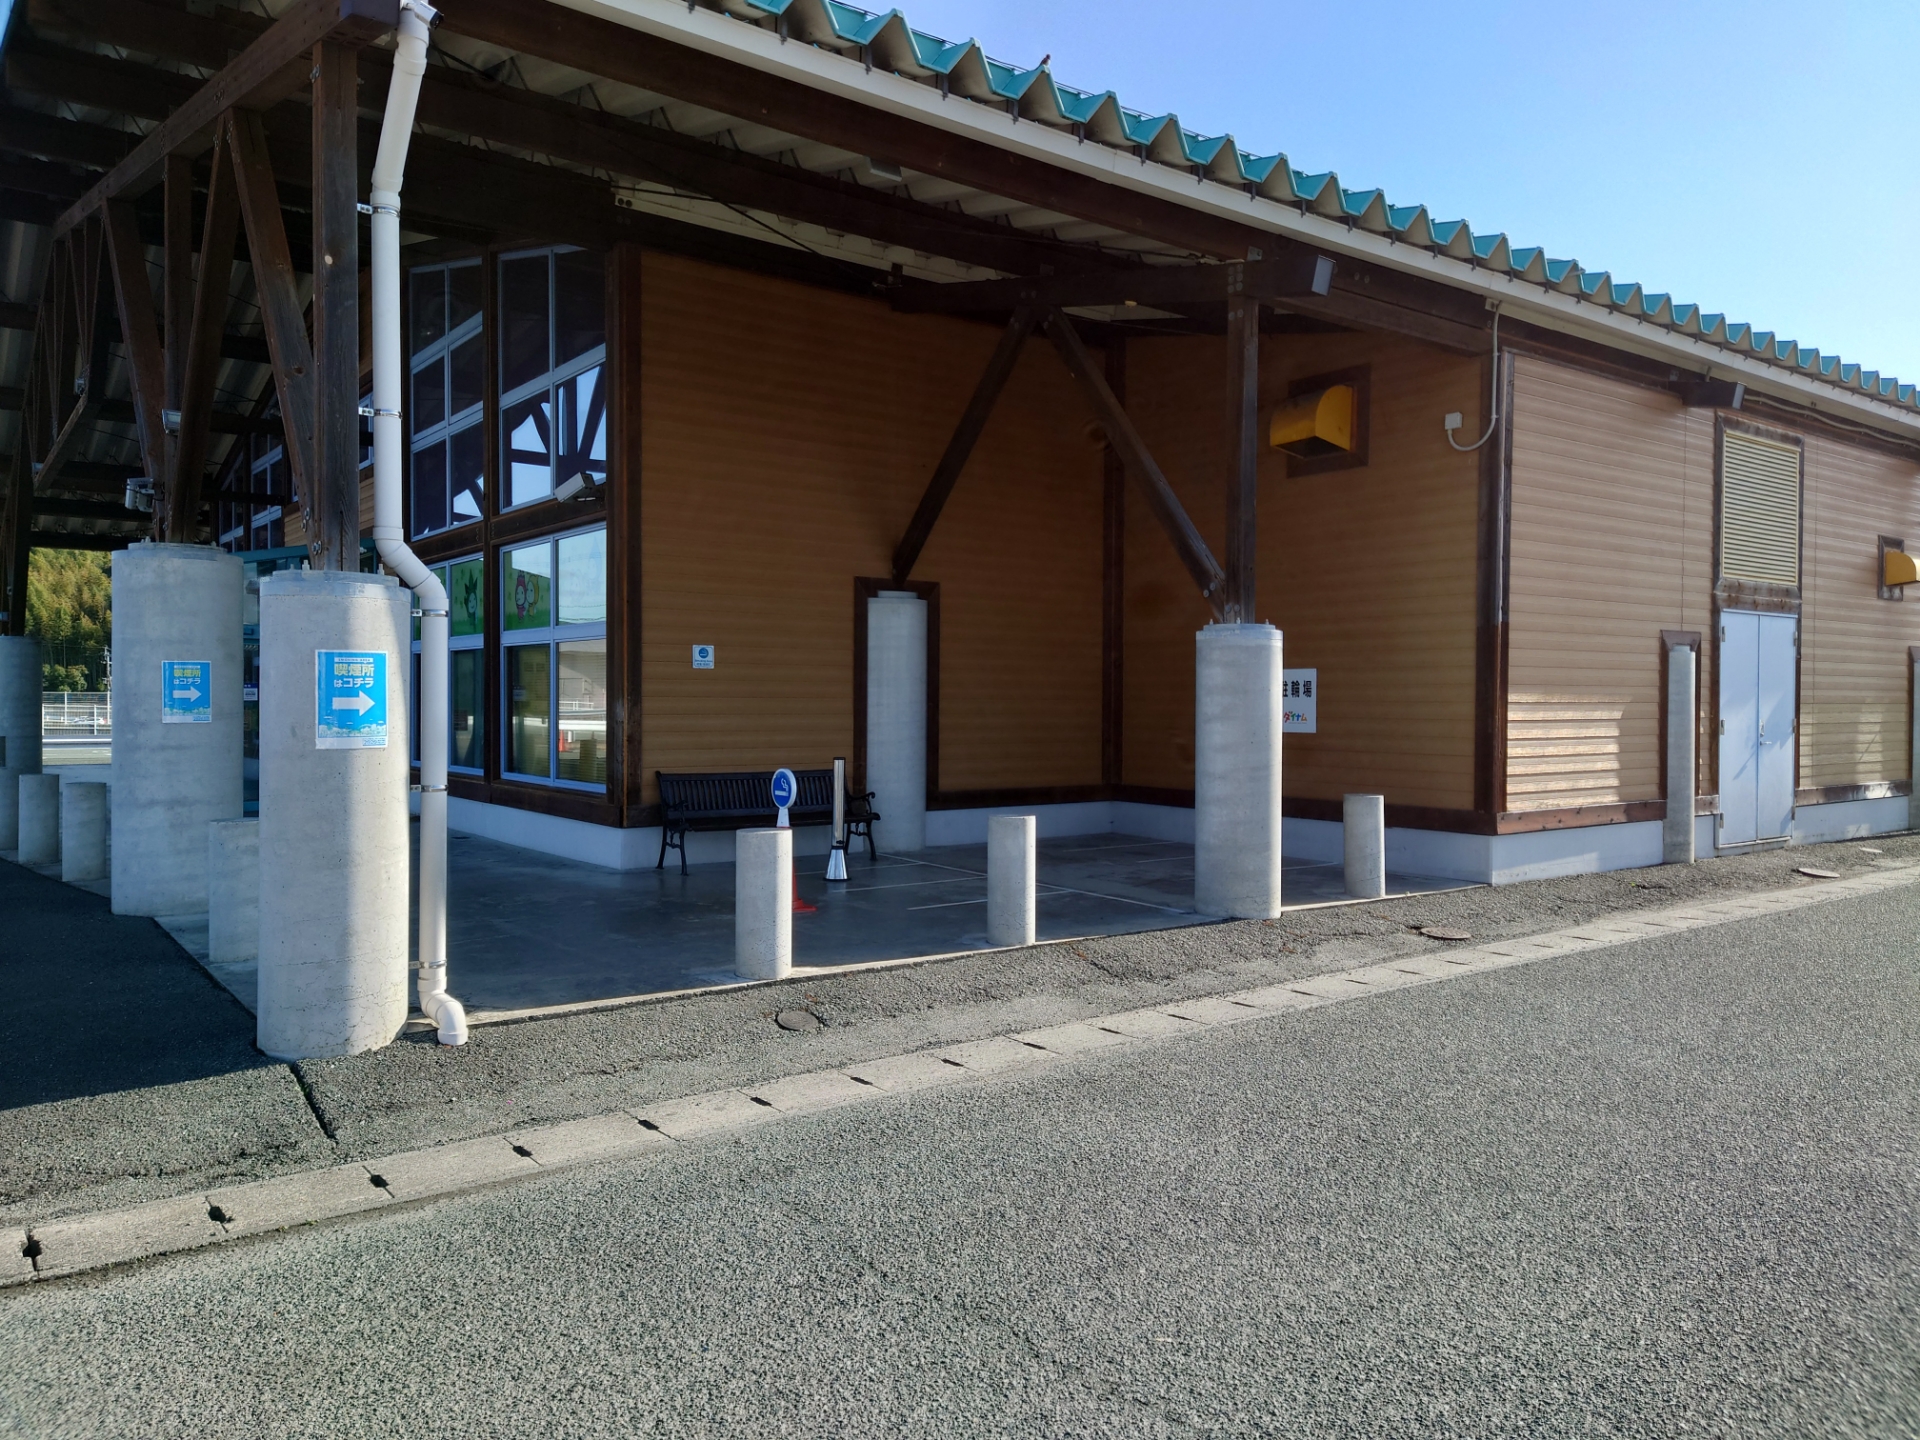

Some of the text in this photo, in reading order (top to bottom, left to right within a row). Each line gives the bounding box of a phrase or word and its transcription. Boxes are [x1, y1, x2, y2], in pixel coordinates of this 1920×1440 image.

[334, 663, 374, 676] 喫煙所
[334, 678, 374, 688] はコチラ
[1284, 711, 1307, 723] ダイナム
